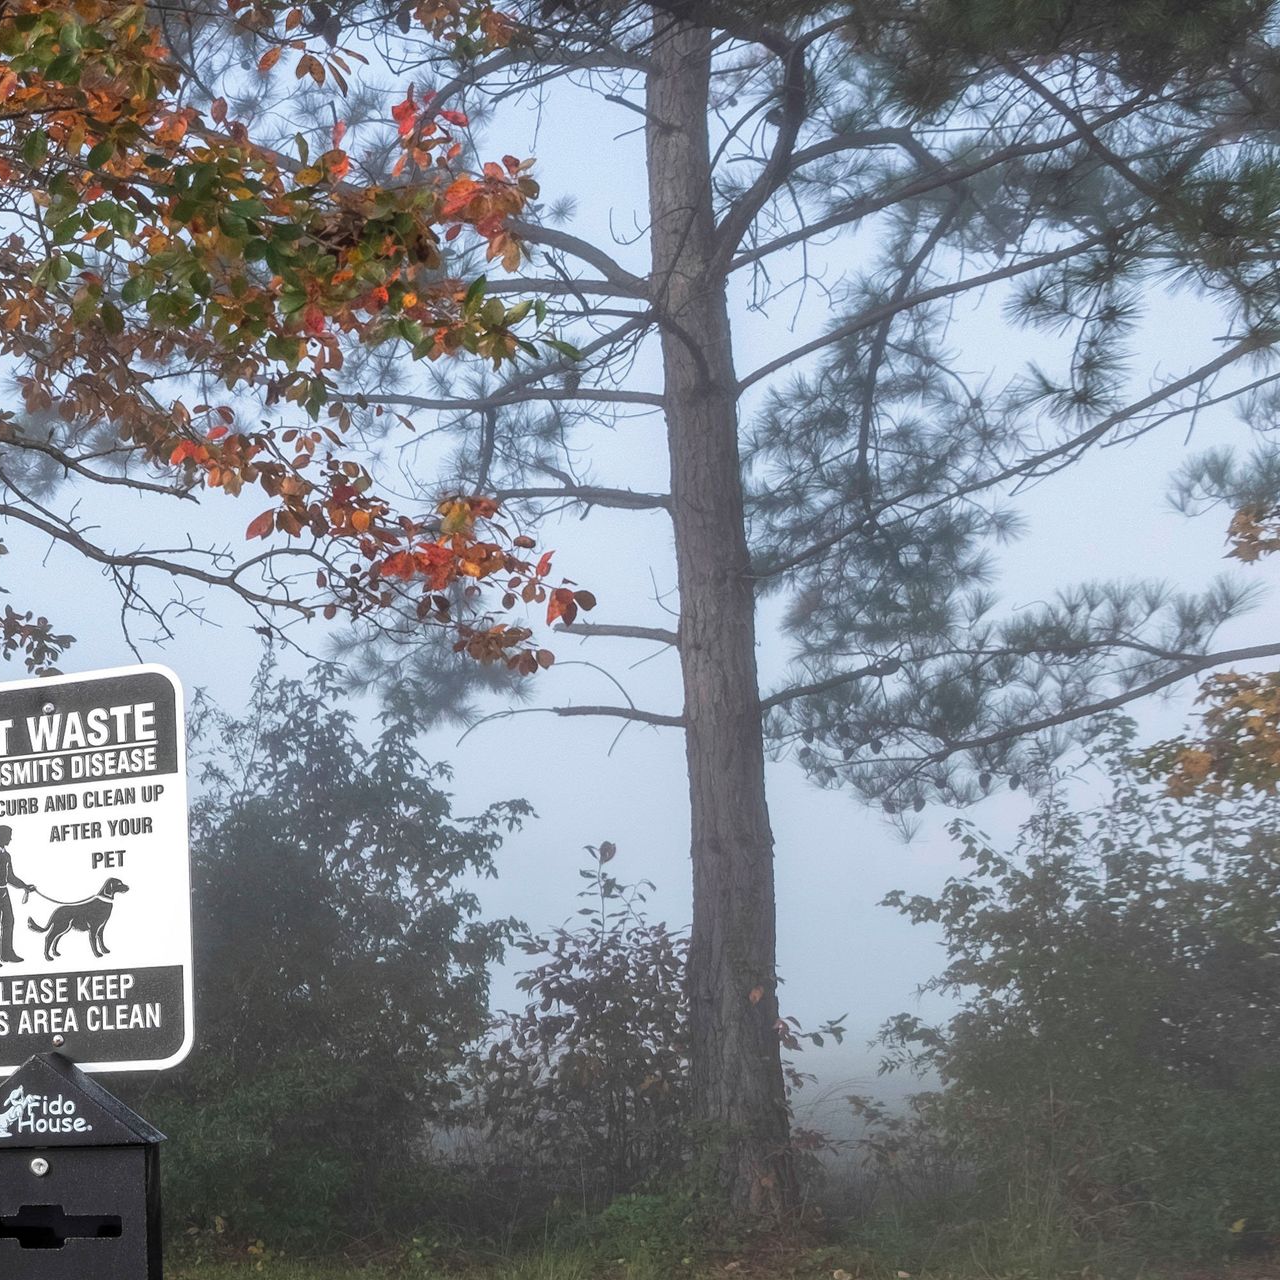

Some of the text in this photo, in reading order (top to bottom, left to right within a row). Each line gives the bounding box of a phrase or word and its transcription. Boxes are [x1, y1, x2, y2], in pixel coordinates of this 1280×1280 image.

[27, 702, 156, 752] WASTE
[71, 747, 157, 780] DISEASE
[44, 792, 78, 813] AND
[82, 787, 136, 808] CLEAN
[141, 784, 165, 802] UP
[50, 816, 153, 843] AFTER YOUR
[91, 850, 127, 869] PET
[76, 974, 135, 1001] KEEP
[18, 1007, 79, 1035] AREA
[86, 1002, 162, 1031] CLEAN
[27, 1093, 76, 1116] Fido
